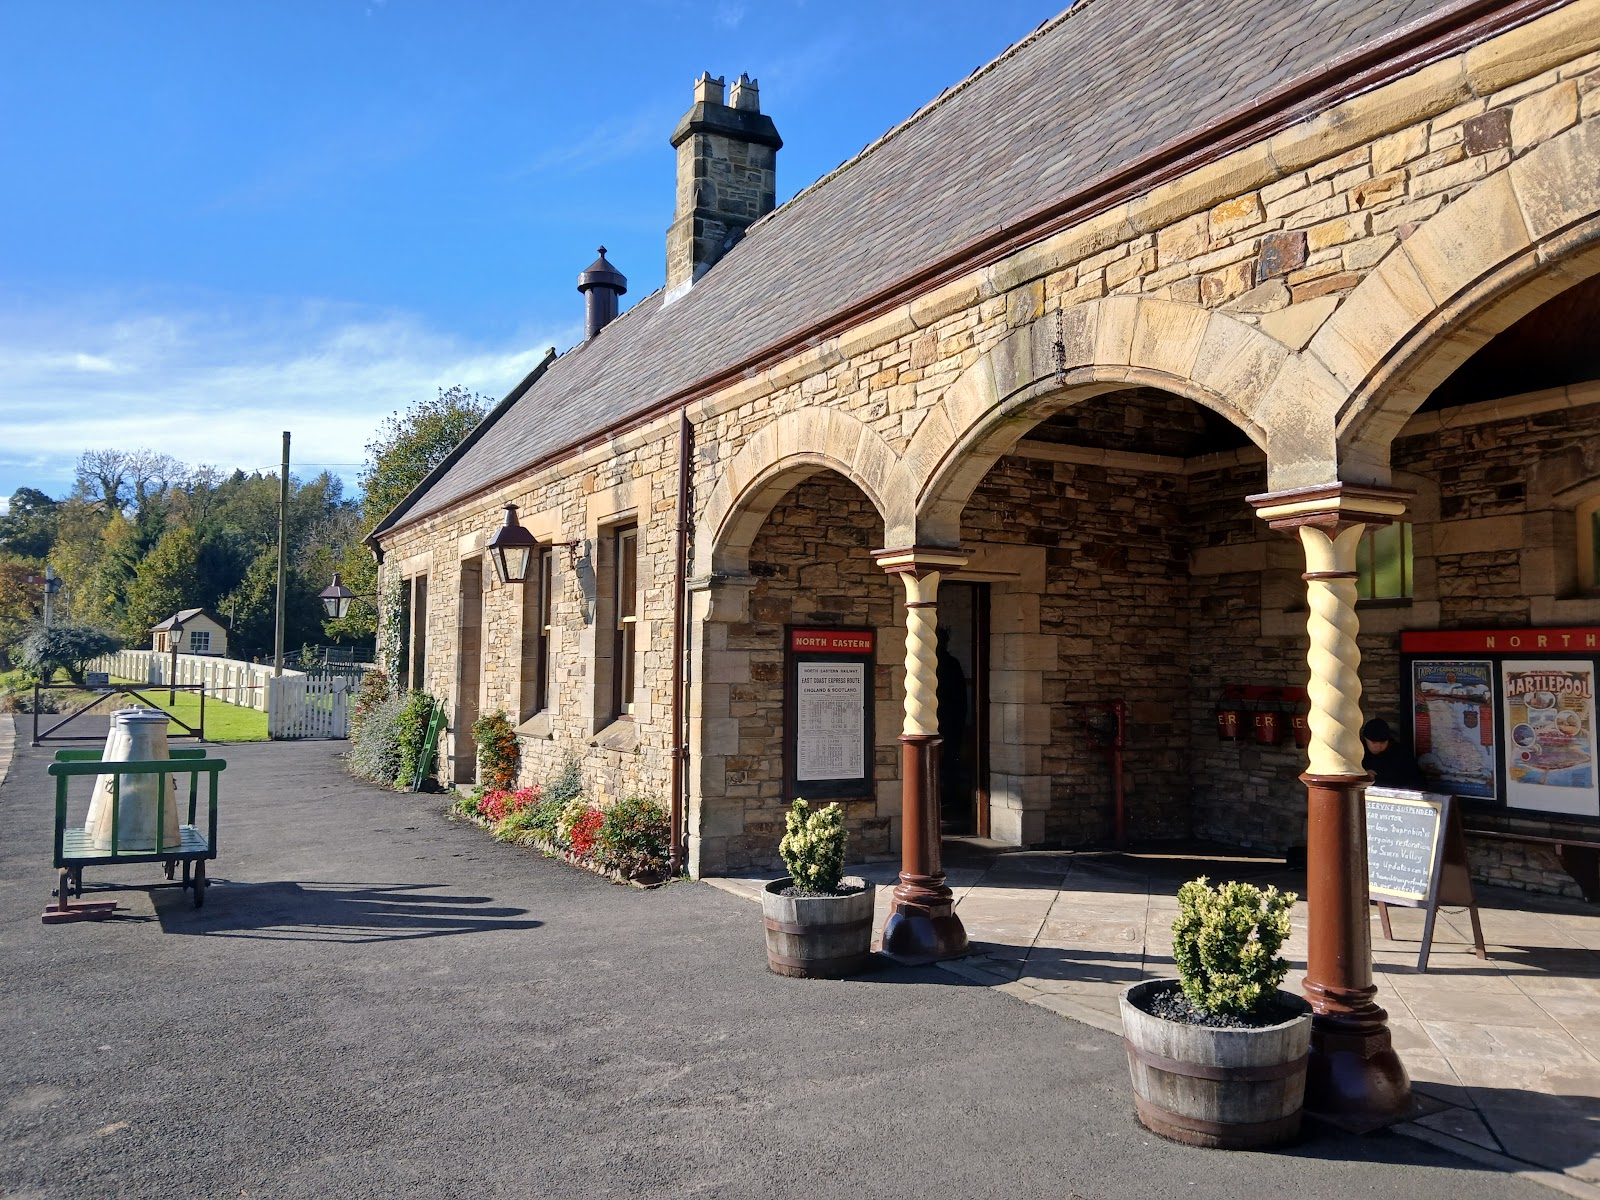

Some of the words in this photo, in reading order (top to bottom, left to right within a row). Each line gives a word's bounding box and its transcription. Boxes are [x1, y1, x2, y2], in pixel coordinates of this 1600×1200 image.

[796, 637, 827, 646] NORTH
[832, 639, 870, 648] EASTERN
[1486, 634, 1596, 648] NORTH
[1506, 676, 1592, 699] HARTLEPOOL
[1367, 802, 1394, 812] SERVICE
[1376, 822, 1388, 832] loco
[1367, 834, 1394, 846] dergoing
[1401, 848, 1423, 864] Valley
